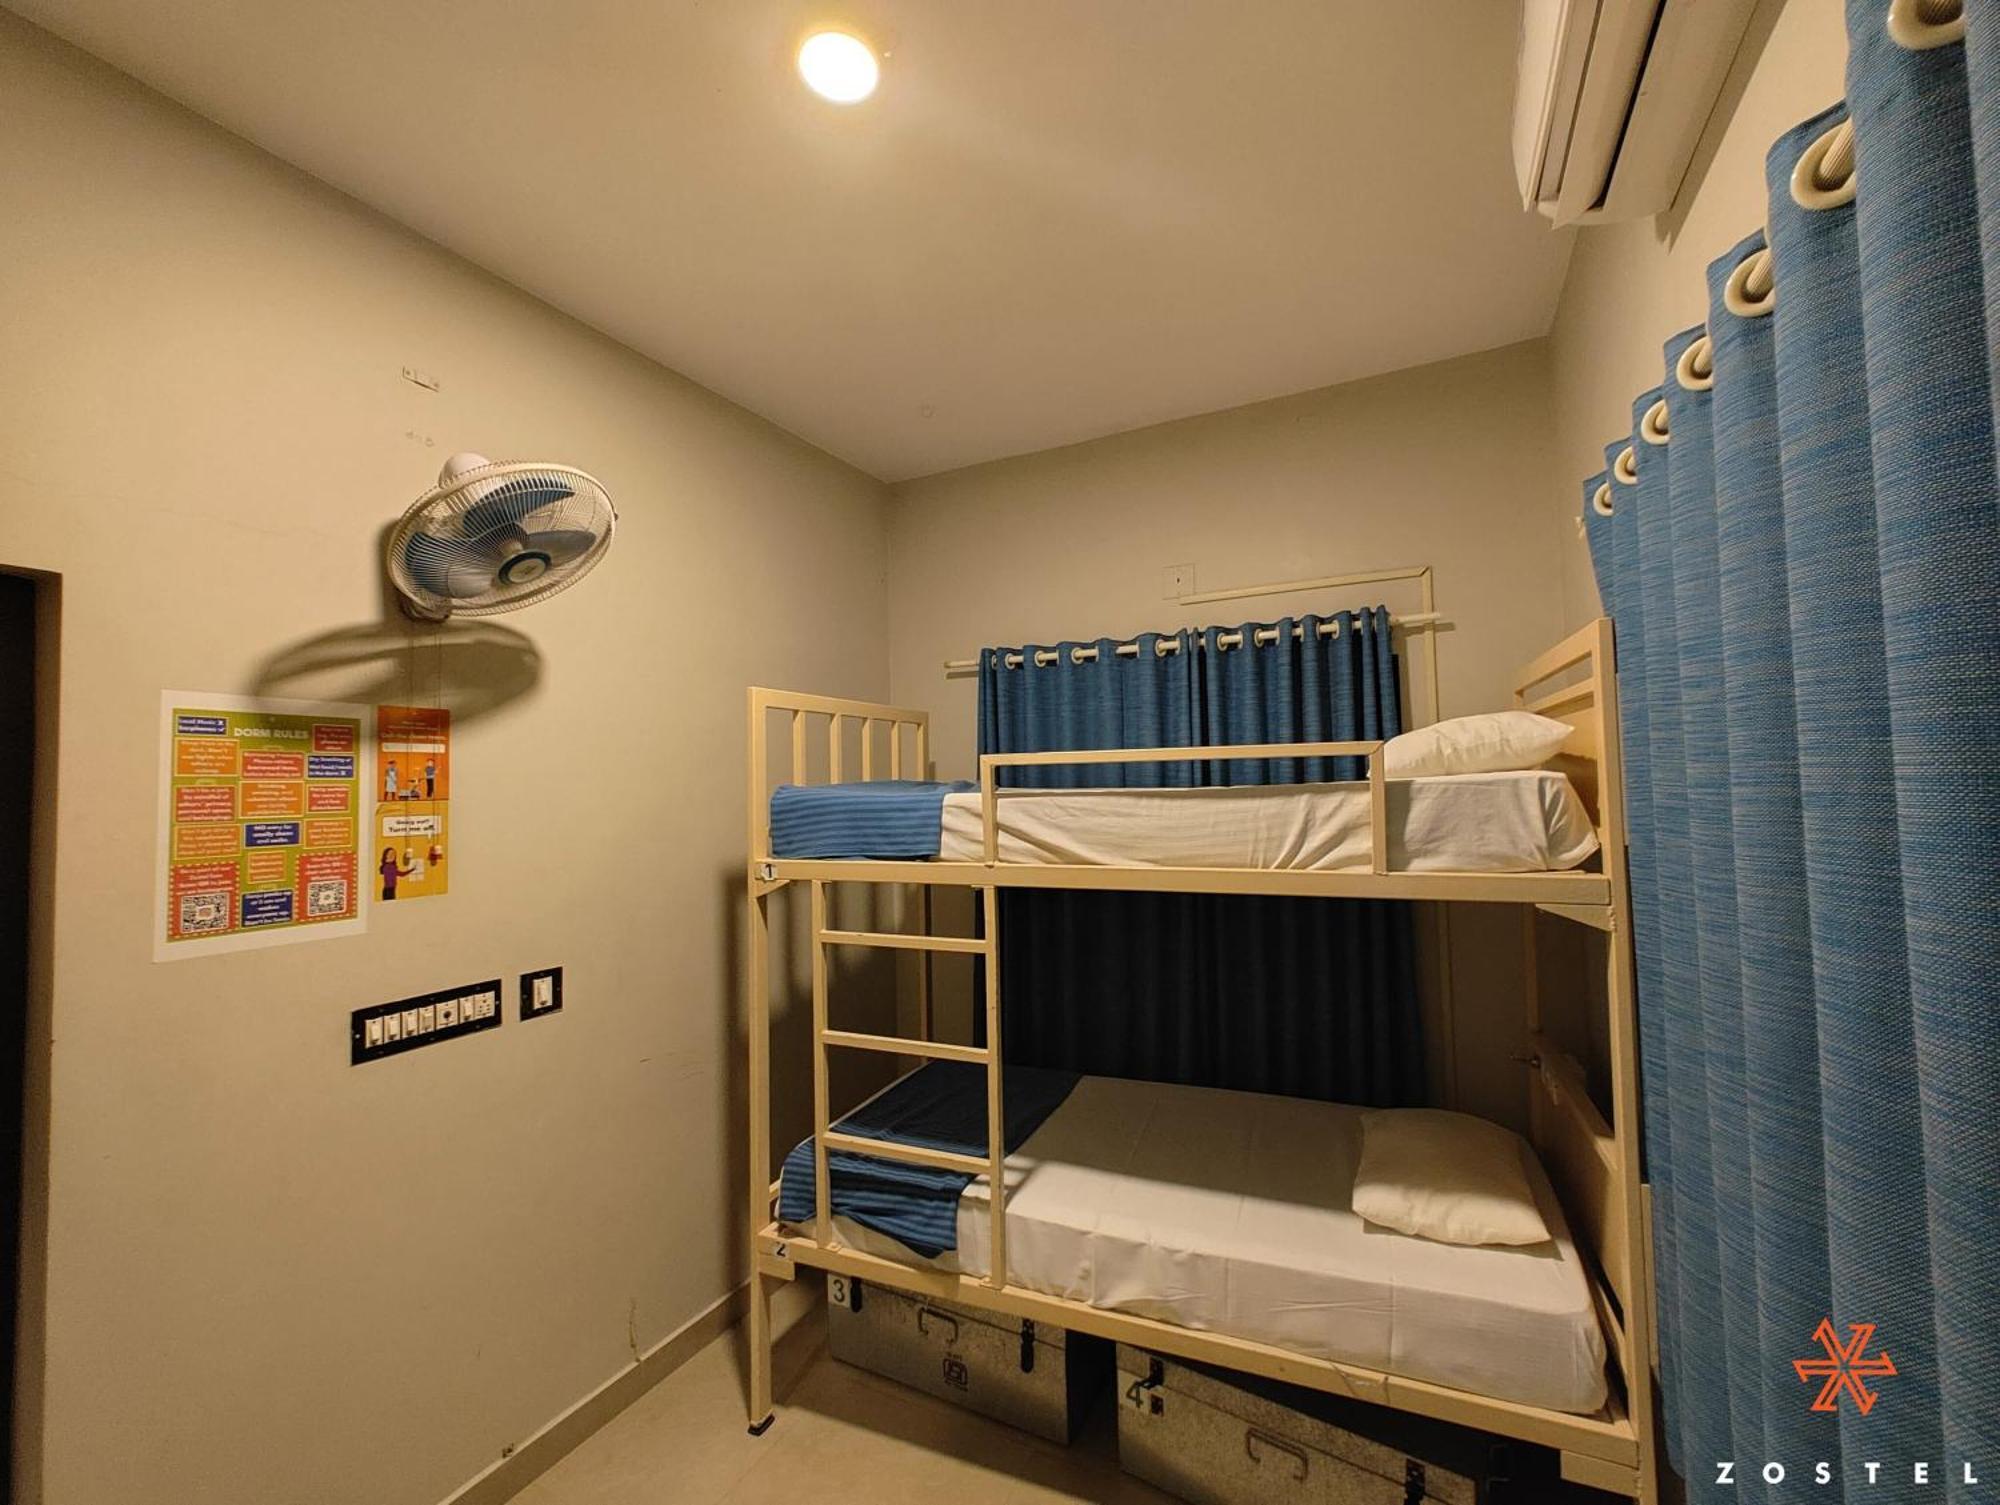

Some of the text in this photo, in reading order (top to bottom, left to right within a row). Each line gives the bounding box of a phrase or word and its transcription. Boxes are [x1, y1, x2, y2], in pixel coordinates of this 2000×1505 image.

[234, 727, 271, 738] DORM
[273, 728, 310, 740] RULES
[765, 863, 773, 879] 1
[775, 1240, 787, 1258] 2
[832, 1278, 845, 1303] 3
[1126, 1380, 1144, 1409] 4
